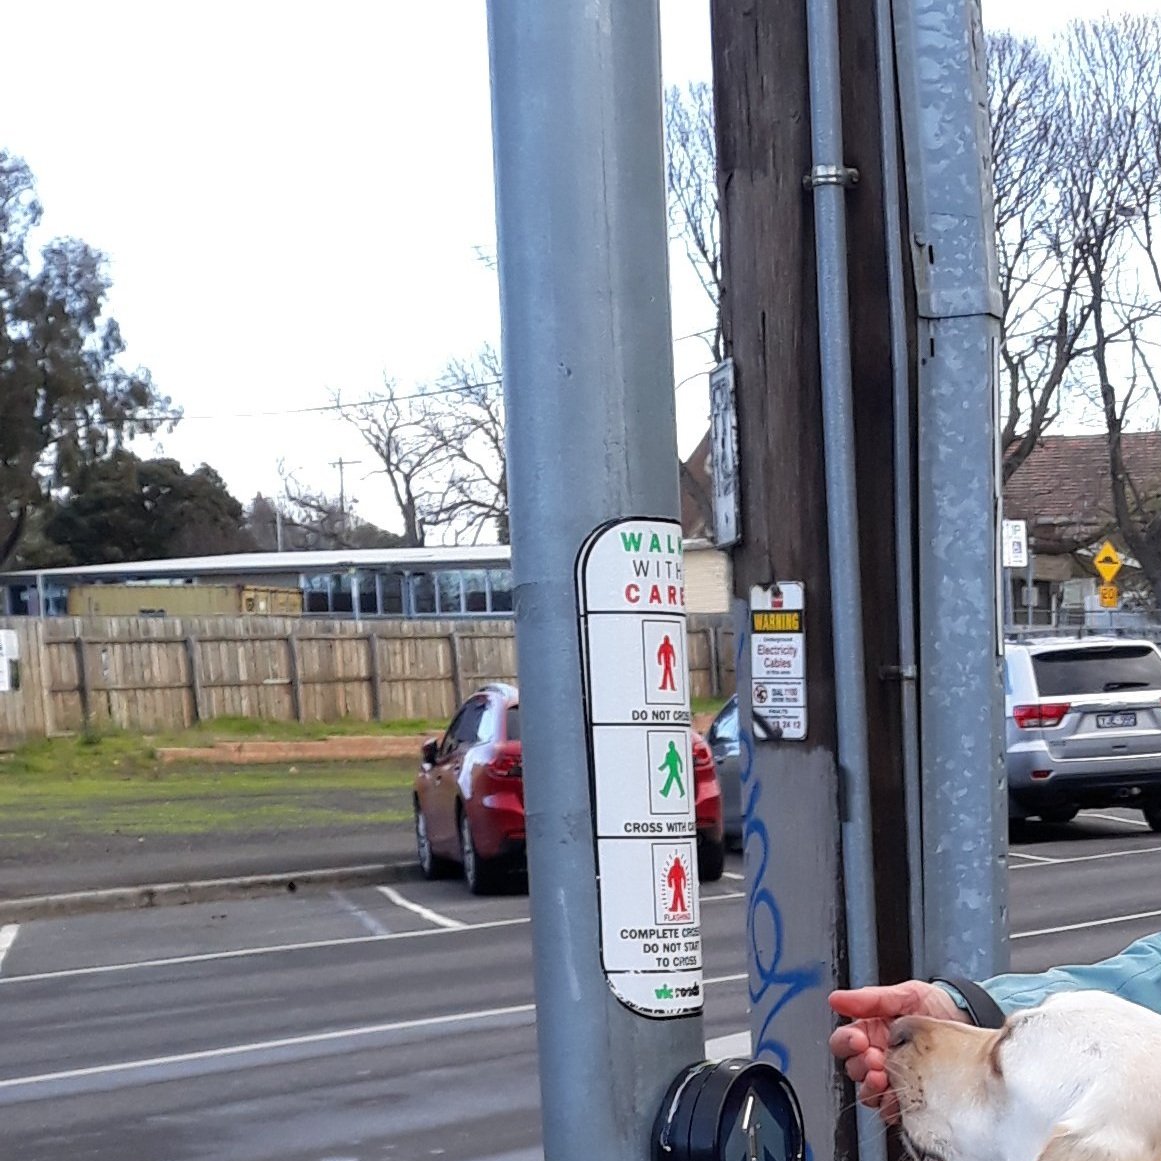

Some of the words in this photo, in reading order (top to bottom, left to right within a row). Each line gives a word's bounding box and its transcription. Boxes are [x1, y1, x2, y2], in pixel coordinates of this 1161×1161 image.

[753, 612, 800, 632] WARNING
[757, 644, 798, 657] Electricity
[763, 658, 792, 668] Cables
[631, 709, 648, 721] DO
[651, 709, 671, 721] NOT
[624, 822, 663, 833] CROSS
[665, 822, 686, 833] WITH
[620, 928, 679, 940] COMPLETE
[643, 943, 659, 954] DO
[662, 942, 681, 953] NOT
[656, 957, 670, 967] TO
